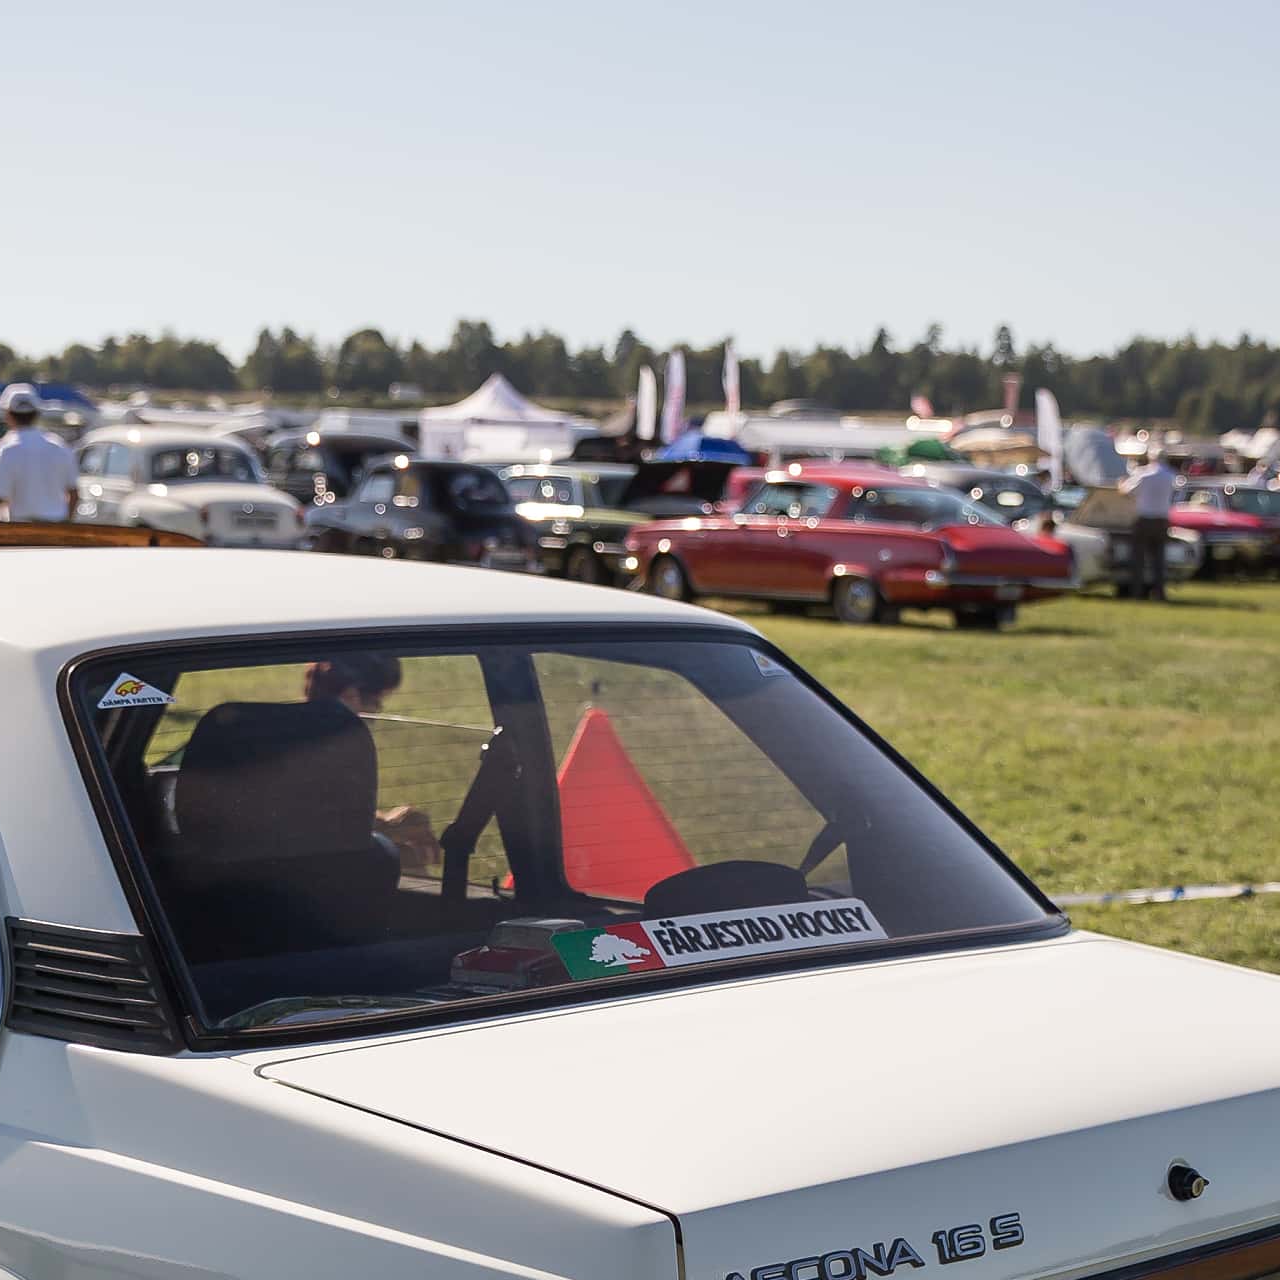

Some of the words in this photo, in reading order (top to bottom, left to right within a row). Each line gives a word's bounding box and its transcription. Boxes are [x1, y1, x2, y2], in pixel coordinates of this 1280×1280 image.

[652, 917, 785, 956] FÄRJESTAD
[779, 906, 873, 939] HOCKEY
[989, 1212, 1025, 1251] S
